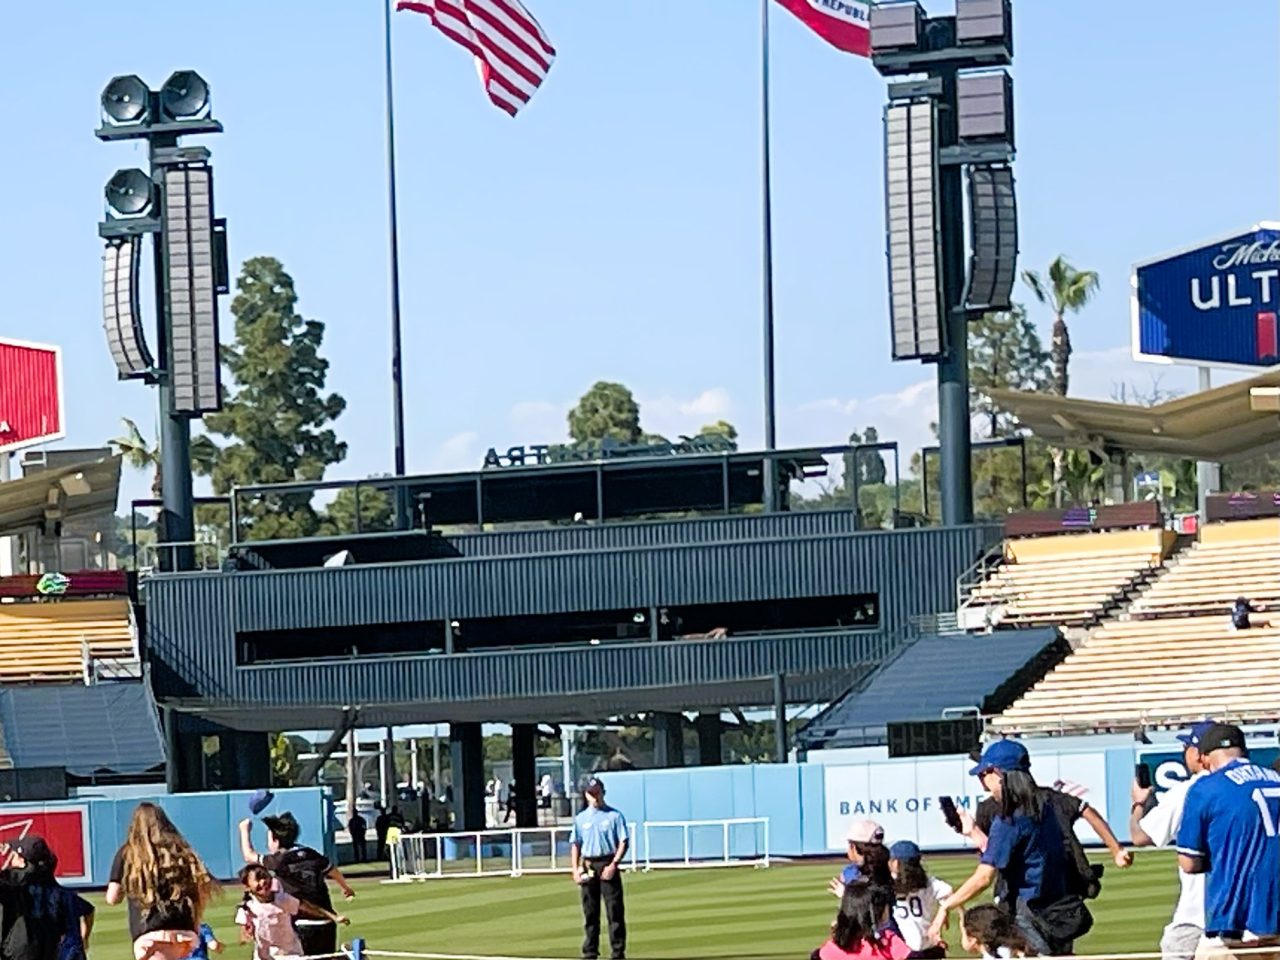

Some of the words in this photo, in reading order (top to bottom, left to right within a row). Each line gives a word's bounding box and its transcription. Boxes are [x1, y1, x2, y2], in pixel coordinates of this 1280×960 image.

[840, 798, 898, 816] BANK
[905, 796, 933, 812] OF
[892, 895, 924, 920] 50
